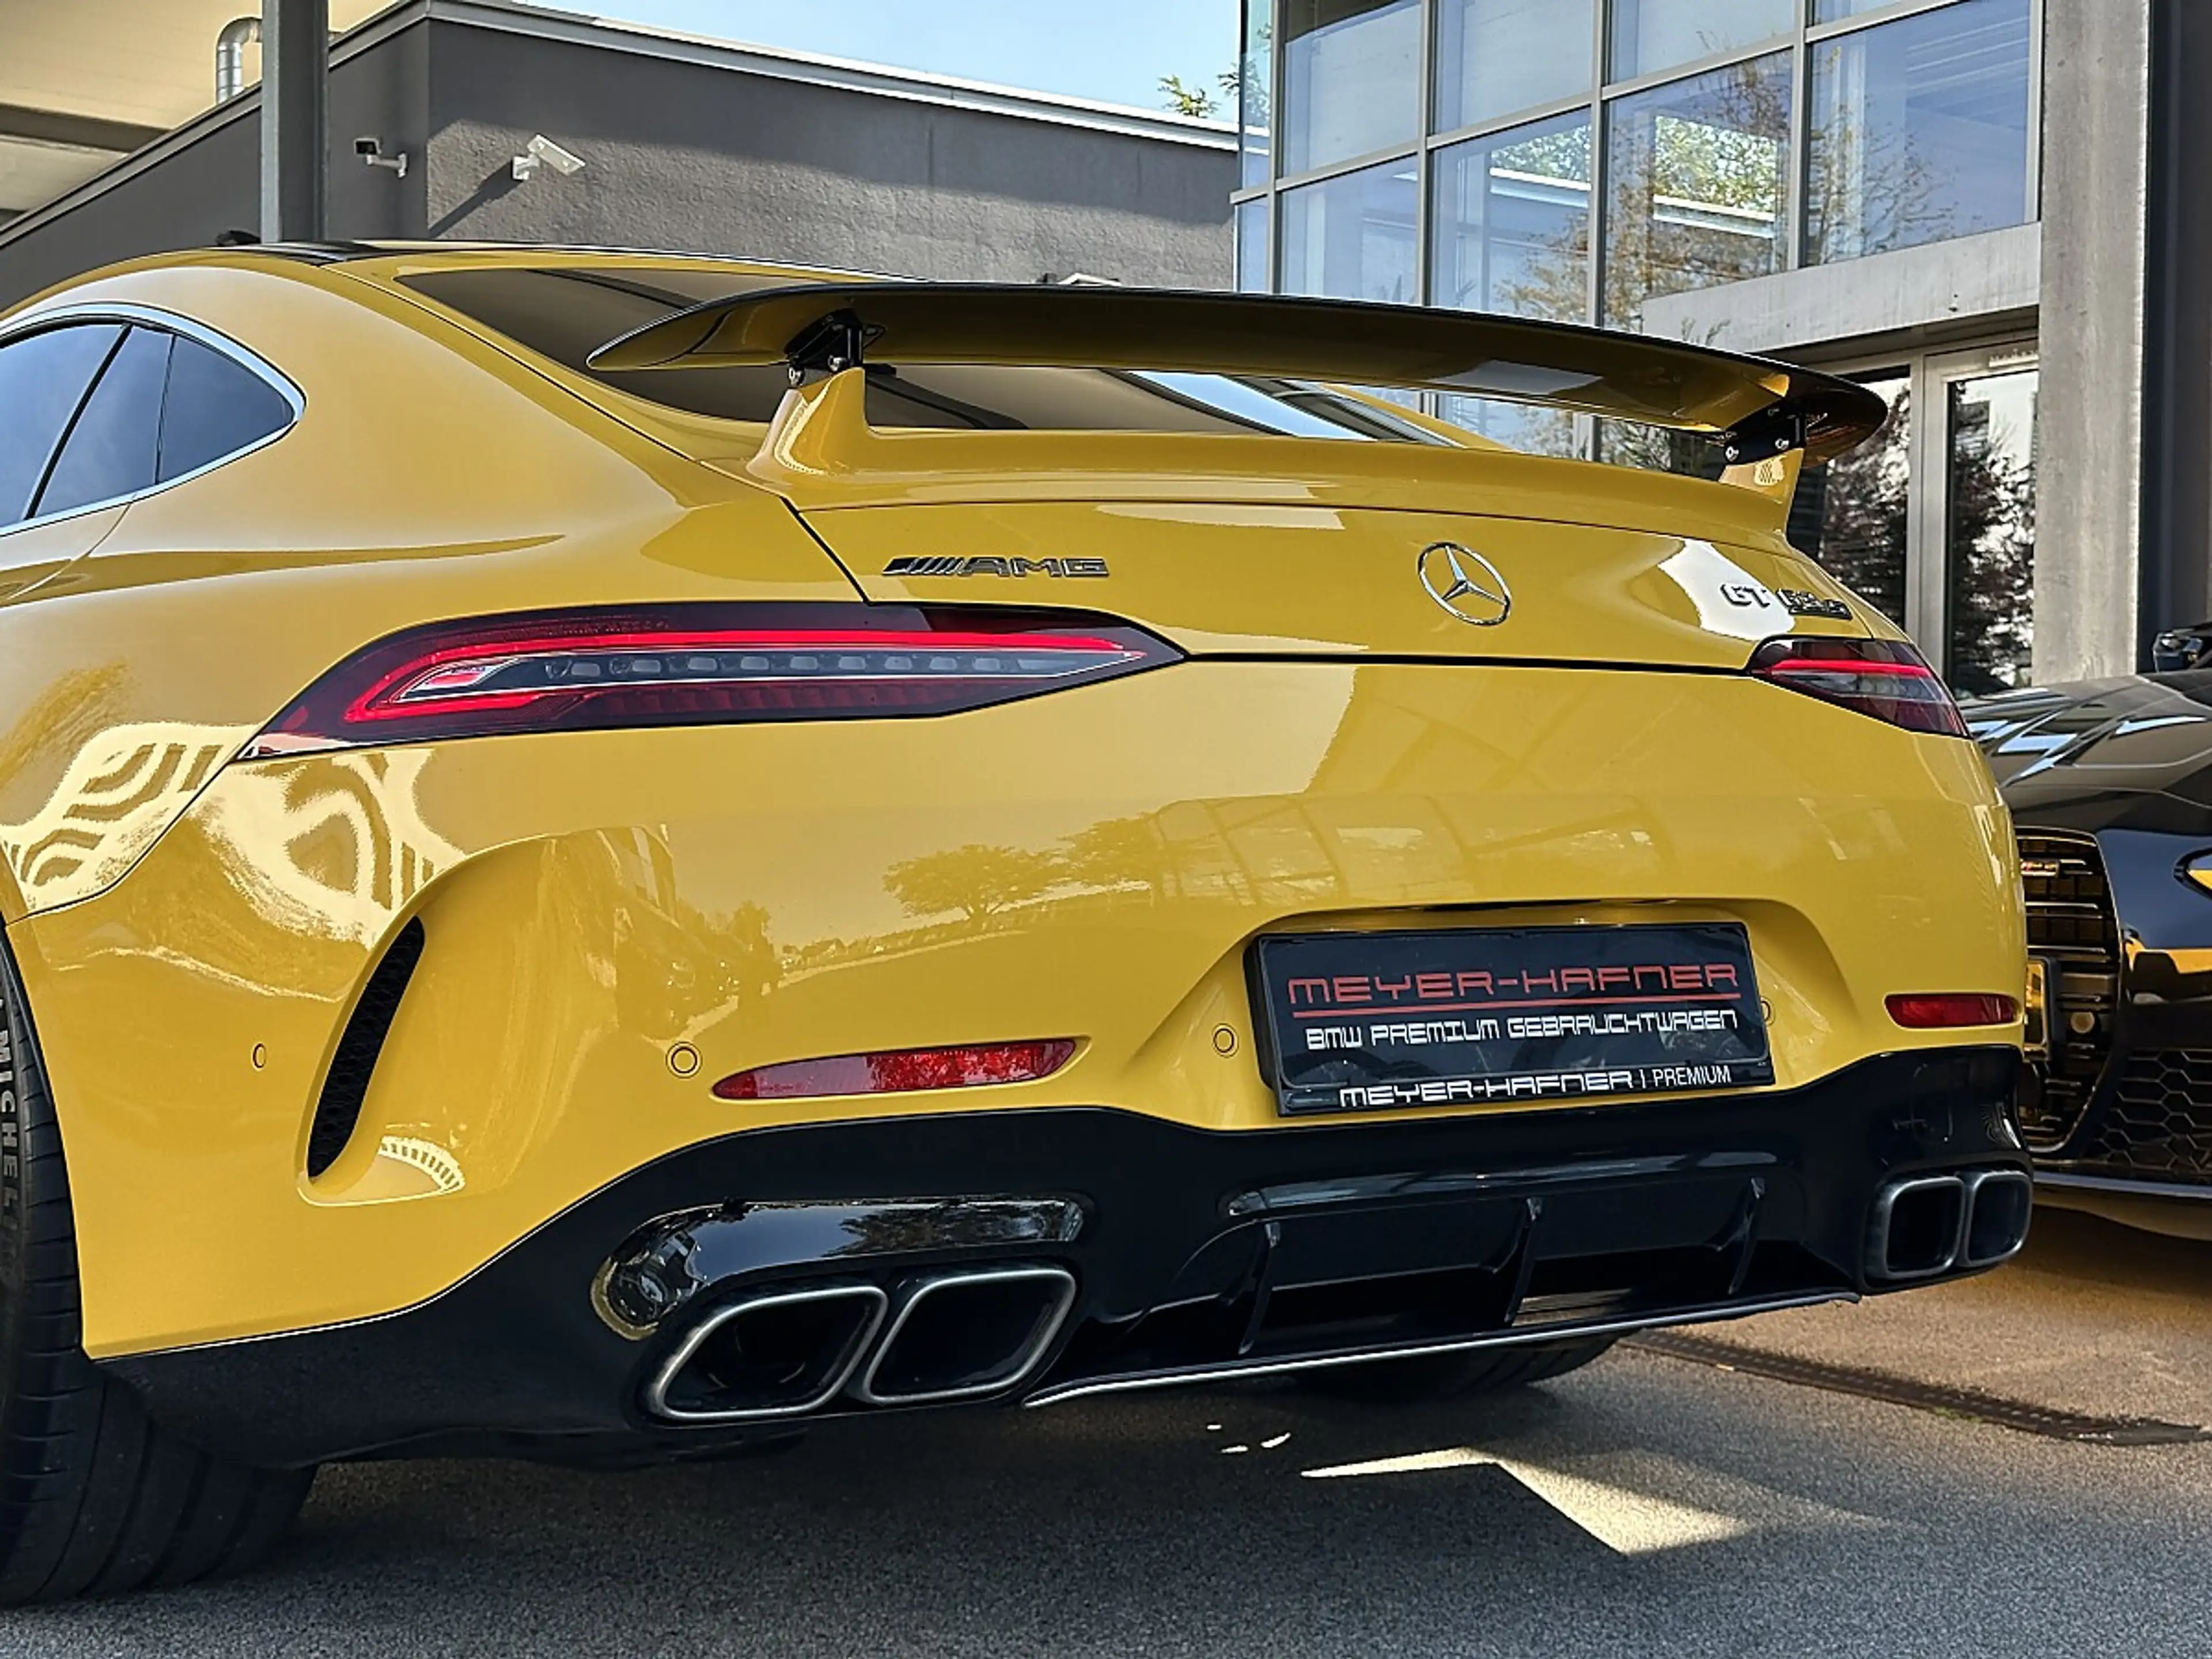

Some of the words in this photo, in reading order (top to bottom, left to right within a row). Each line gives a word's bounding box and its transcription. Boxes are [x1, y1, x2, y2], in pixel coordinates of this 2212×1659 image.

[957, 556, 1110, 577] AMG
[1288, 964, 1738, 1004] MEYER-HAFNER
[1305, 1023, 1363, 1051] BMW
[1369, 1018, 1501, 1046] PREMIUM
[1506, 1009, 1738, 1039] GEBRAUCHTWAGEN
[1339, 1070, 1634, 1108] MEYER-HAFNER
[1652, 1065, 1732, 1087] PREMIUM
